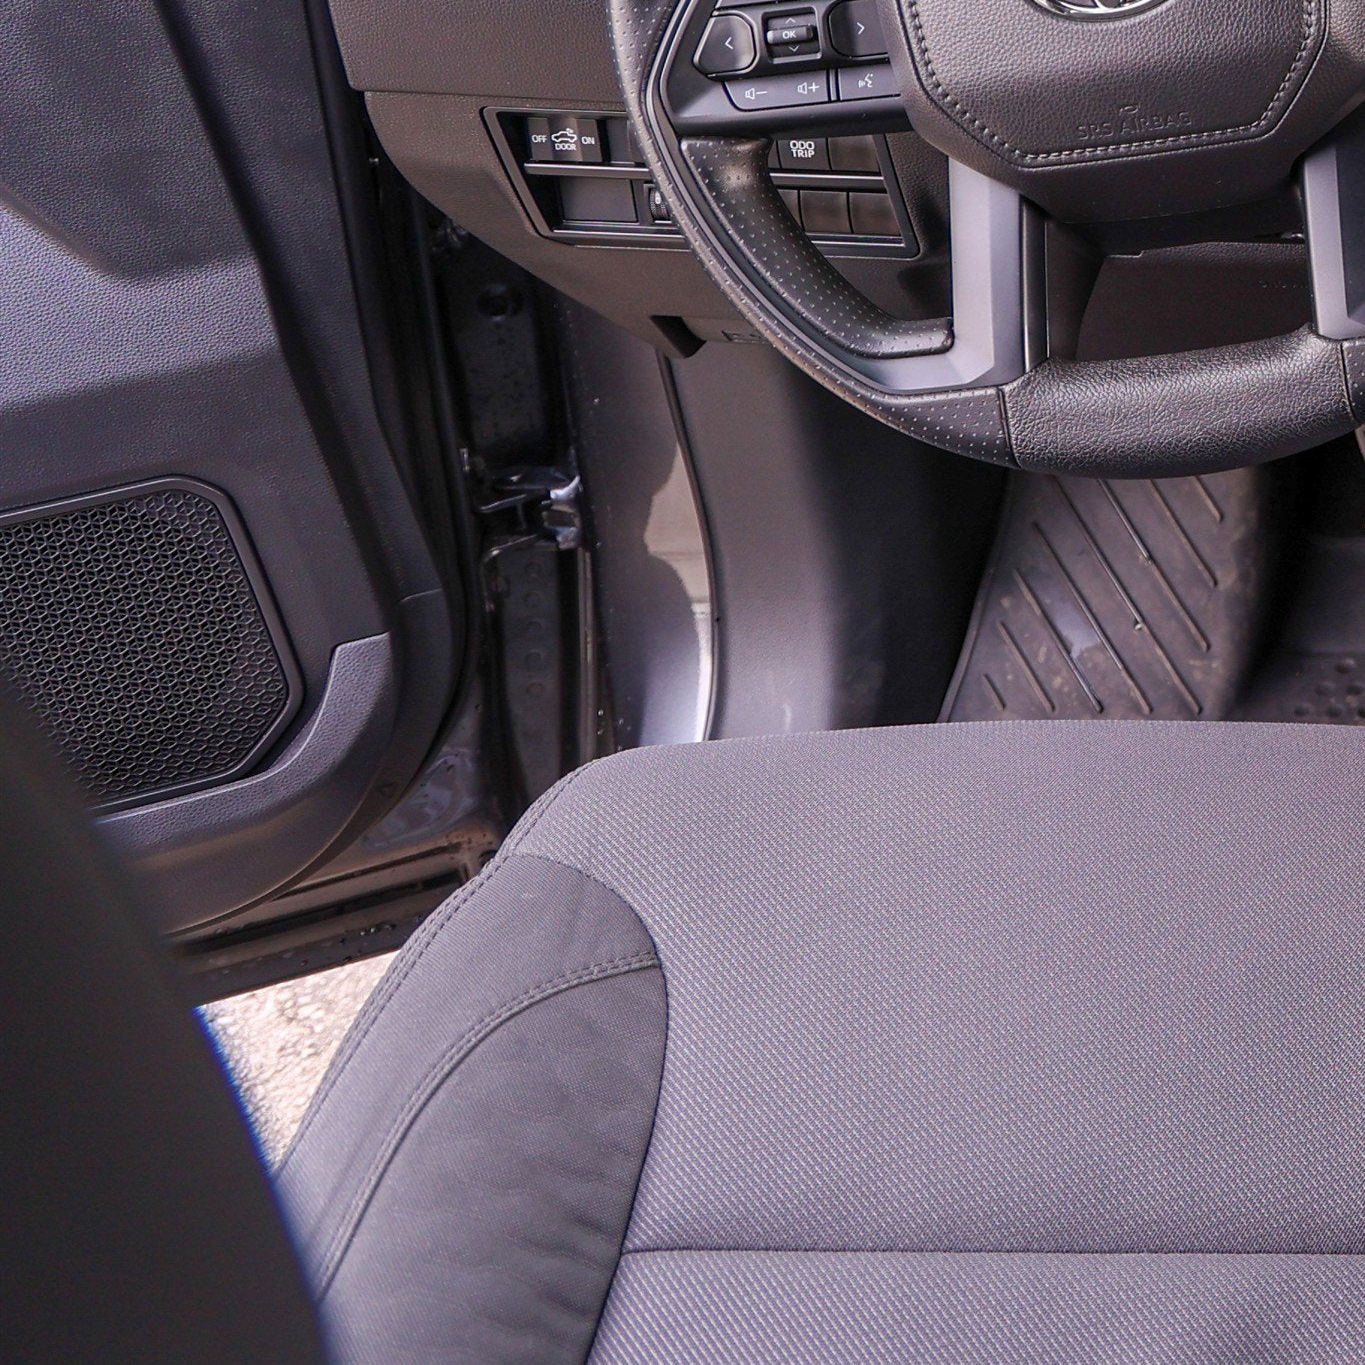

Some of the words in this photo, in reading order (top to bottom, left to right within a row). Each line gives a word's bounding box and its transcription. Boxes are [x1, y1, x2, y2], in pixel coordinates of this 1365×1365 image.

[782, 31, 797, 39] OK
[1078, 123, 1114, 139] SRS
[1120, 112, 1192, 135] AIRBAG
[532, 134, 548, 143] OFF
[582, 136, 596, 145] ON
[555, 143, 577, 151] DOOR
[790, 140, 815, 150] ODO
[790, 149, 815, 158] TRIP
